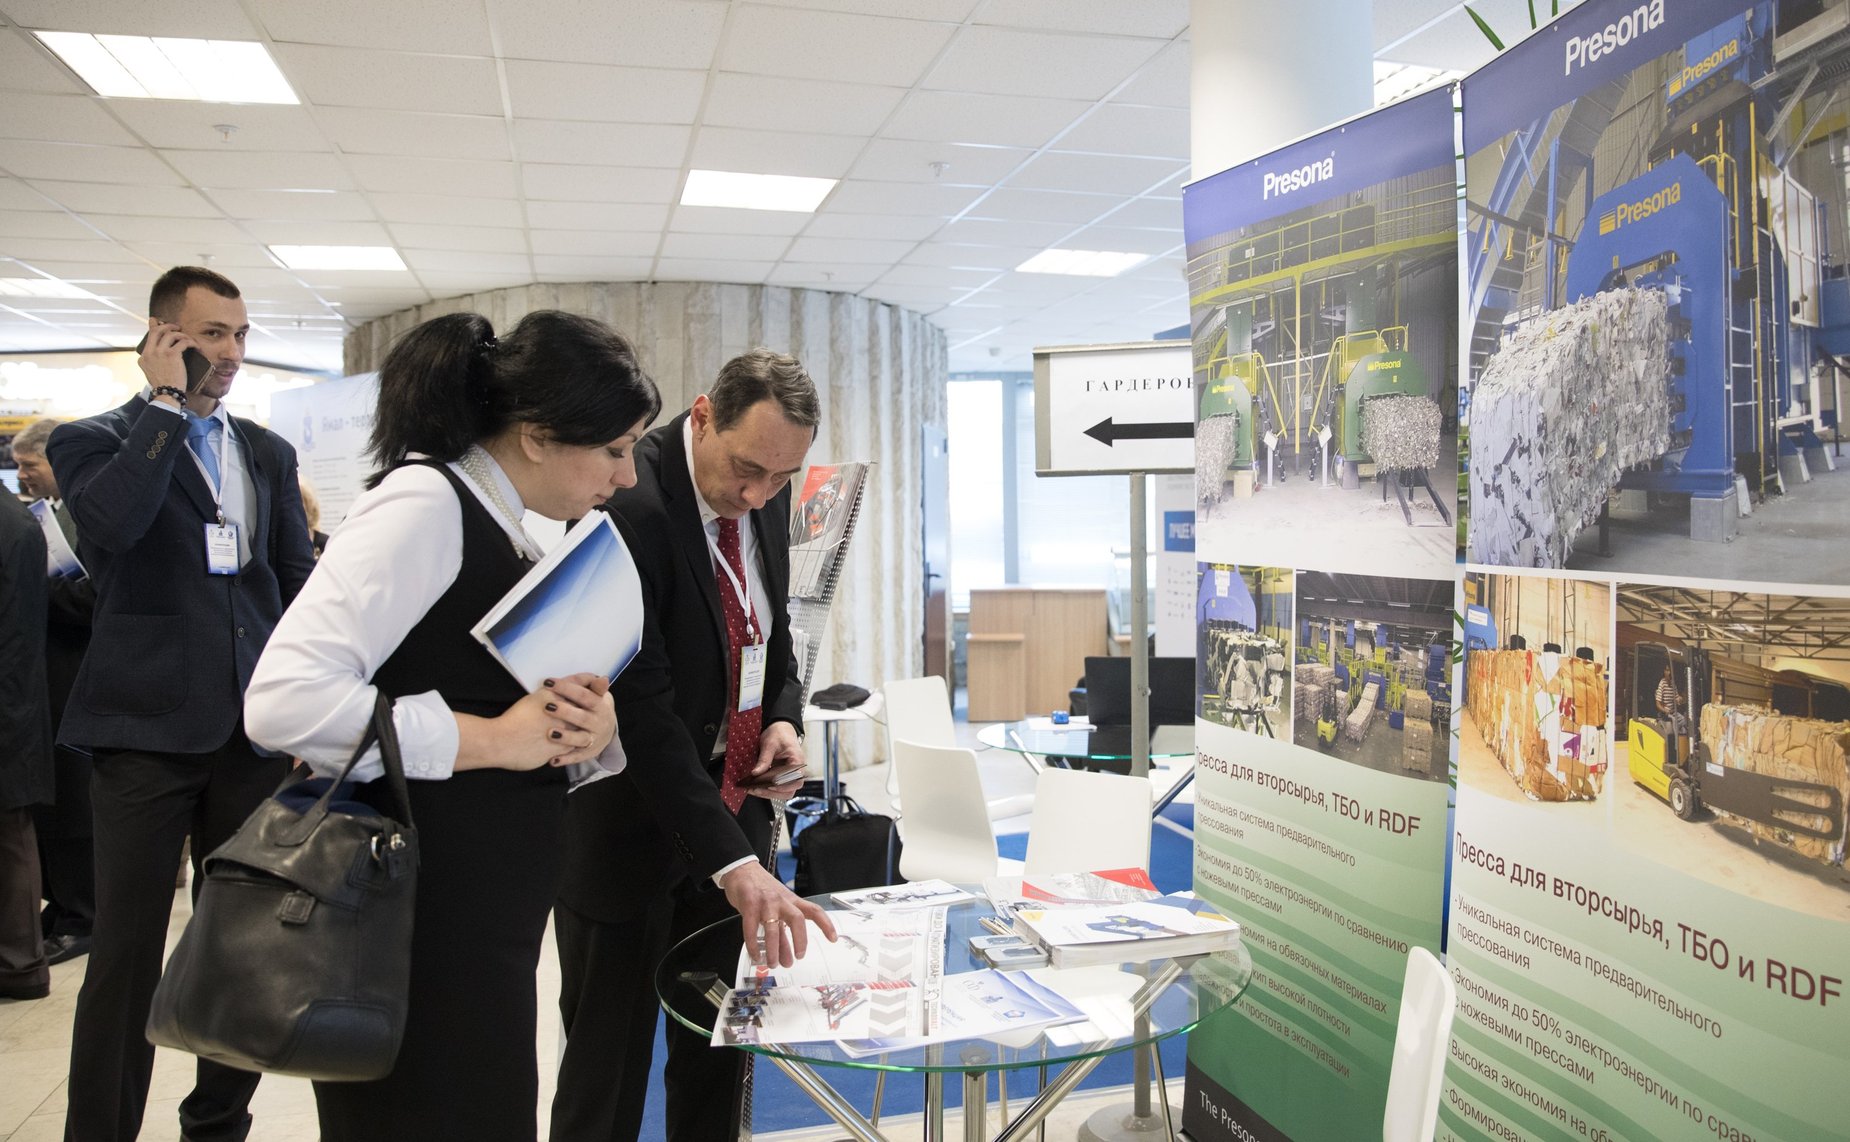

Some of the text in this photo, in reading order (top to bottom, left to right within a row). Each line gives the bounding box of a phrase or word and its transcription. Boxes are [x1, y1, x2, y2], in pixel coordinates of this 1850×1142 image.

[1565, 0, 1664, 76] Presona
[1682, 38, 1738, 86] Presona
[1264, 155, 1334, 200] Presona
[1617, 182, 1681, 229] Presona
[1374, 360, 1401, 371] Presona
[1231, 764, 1253, 783] для
[1257, 771, 1328, 812] вторсырья,
[1331, 792, 1360, 821] ТБО
[1364, 808, 1373, 826] и
[1379, 808, 1420, 837] RDF
[1239, 810, 1275, 832] система
[1277, 822, 1355, 867] предварительного
[1200, 867, 1239, 892] ножевыми
[1240, 885, 1282, 914] прессами
[1232, 863, 1243, 877] до
[1244, 867, 1263, 886] 50%
[1263, 878, 1333, 920] электроэнергии
[1334, 911, 1345, 926] по
[1346, 917, 1408, 954] сравнению
[1455, 830, 1843, 1007] Пресса для вторсырья, ТБО и RDF
[1267, 937, 1278, 951] на
[1279, 943, 1331, 982] обвязочных
[1331, 973, 1388, 1014] материалах
[1457, 922, 1530, 970] прессования
[1458, 895, 1722, 1038] Уникальная система предварительного
[1246, 1001, 1282, 1031] простота
[1284, 1026, 1290, 1037] в
[1290, 1030, 1351, 1079] эксплуатации
[1268, 977, 1307, 1007] высокой
[1307, 1001, 1351, 1036] плотности
[1460, 1000, 1594, 1084] ножевыми прессами
[1455, 967, 1510, 1012] Экономия
[1512, 1003, 1529, 1022] до
[1531, 1009, 1562, 1039] 50%
[1565, 1028, 1679, 1110] электроэнергии
[1683, 1100, 1703, 1123] по
[1199, 1090, 1218, 1119] The
[1450, 1039, 1499, 1083] Высокая
[1501, 1074, 1567, 1123] экономия
[1571, 1115, 1587, 1137] на
